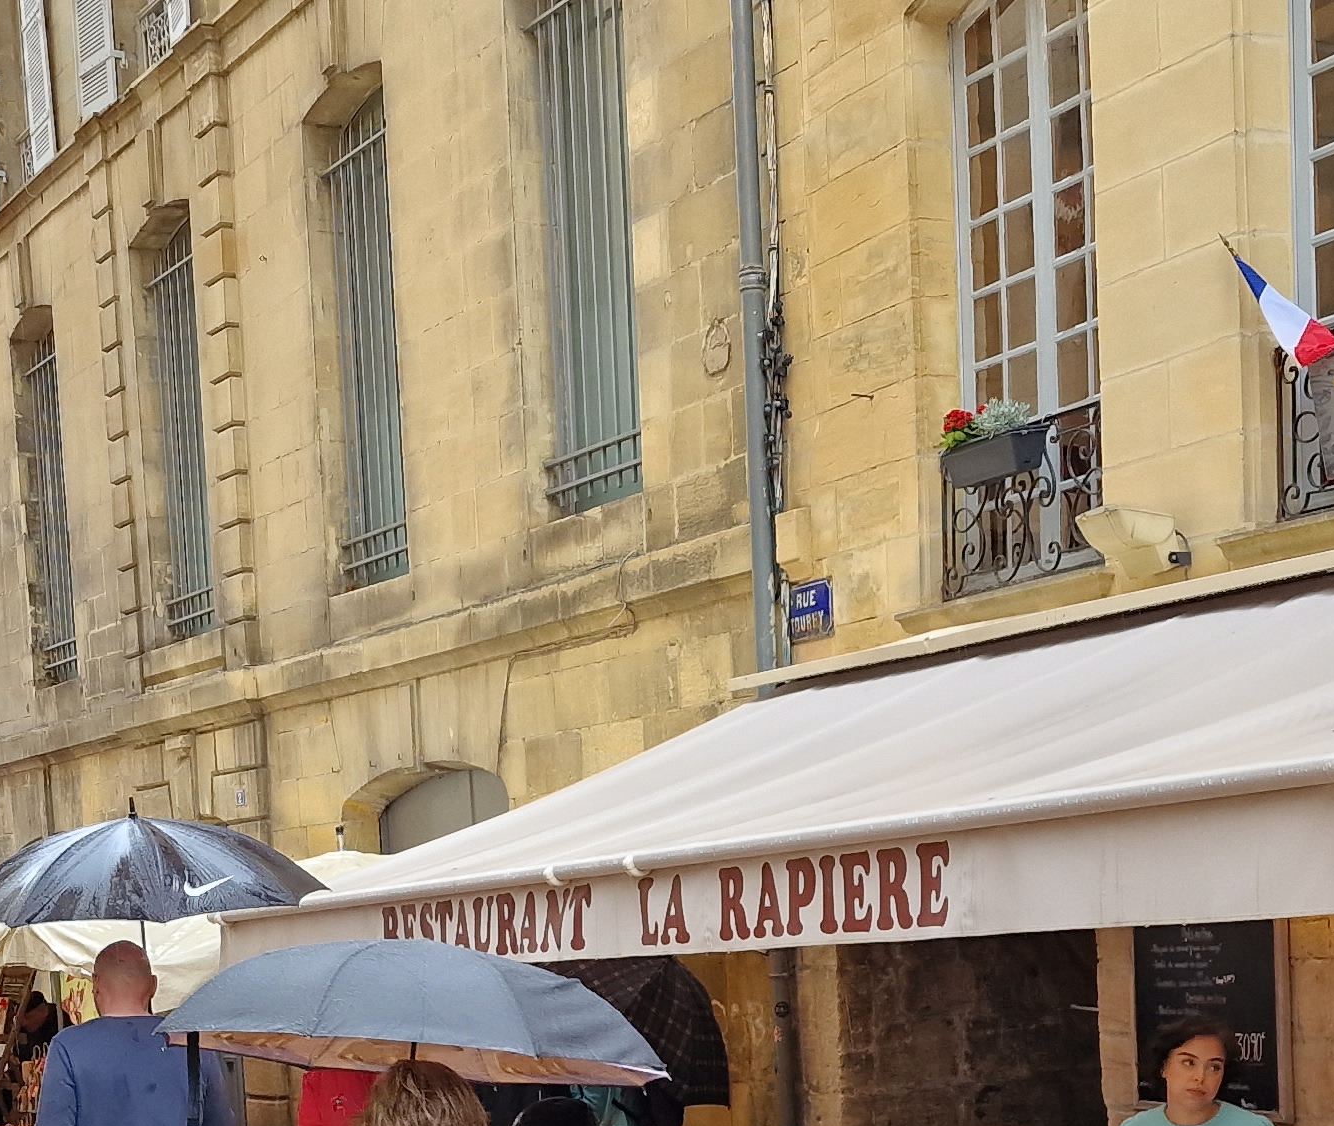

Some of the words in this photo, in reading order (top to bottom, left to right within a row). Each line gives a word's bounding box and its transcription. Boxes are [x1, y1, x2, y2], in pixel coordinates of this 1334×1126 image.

[796, 589, 817, 611] RUE
[638, 873, 690, 947] LA
[719, 840, 950, 941] RAPIERE
